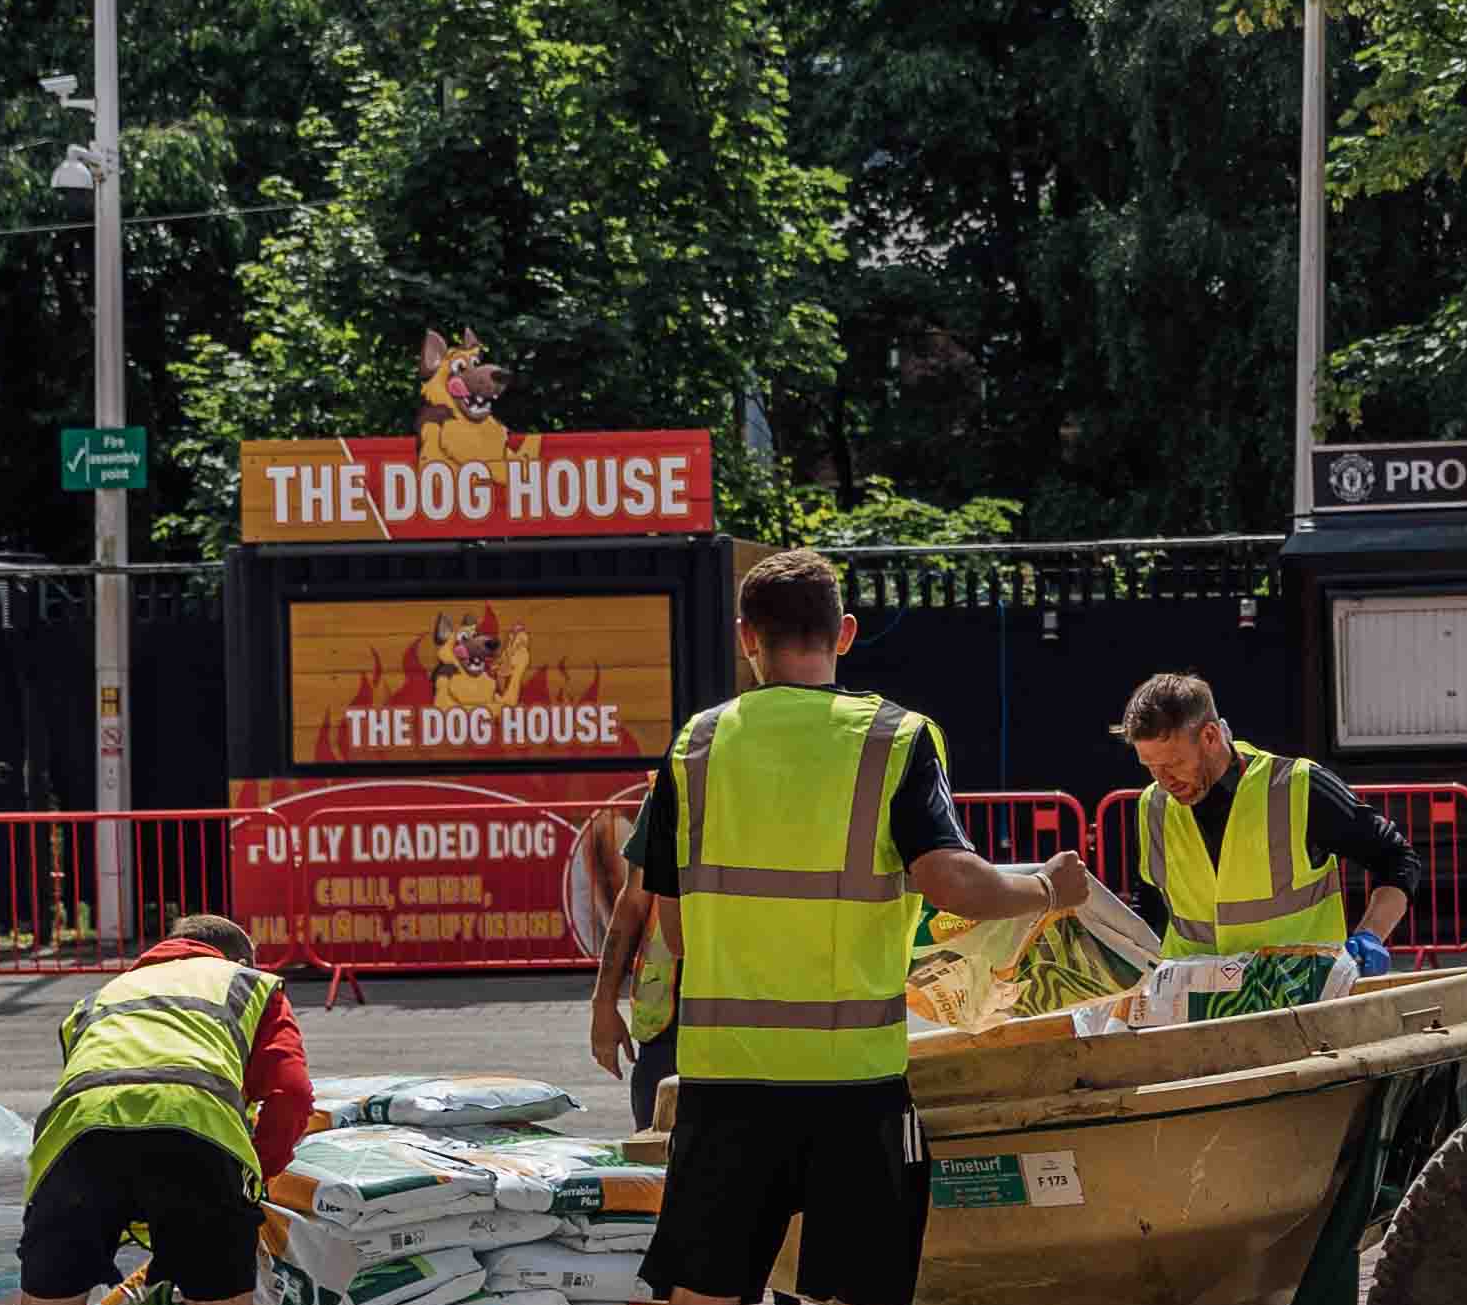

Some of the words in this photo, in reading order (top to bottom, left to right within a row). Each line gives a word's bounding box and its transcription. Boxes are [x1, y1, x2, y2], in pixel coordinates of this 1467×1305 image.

[265, 464, 369, 523] THE
[382, 461, 493, 521] DOG
[508, 456, 690, 520] HOUSE
[346, 709, 413, 747] THE
[421, 707, 492, 745] DOG
[501, 705, 620, 745] HOUSE
[352, 823, 480, 862] LOADED
[488, 822, 556, 860] DOG
[940, 1155, 1001, 1174] Fineturf
[1048, 1175, 1069, 1187] 173
[580, 1196, 601, 1208] Plus
